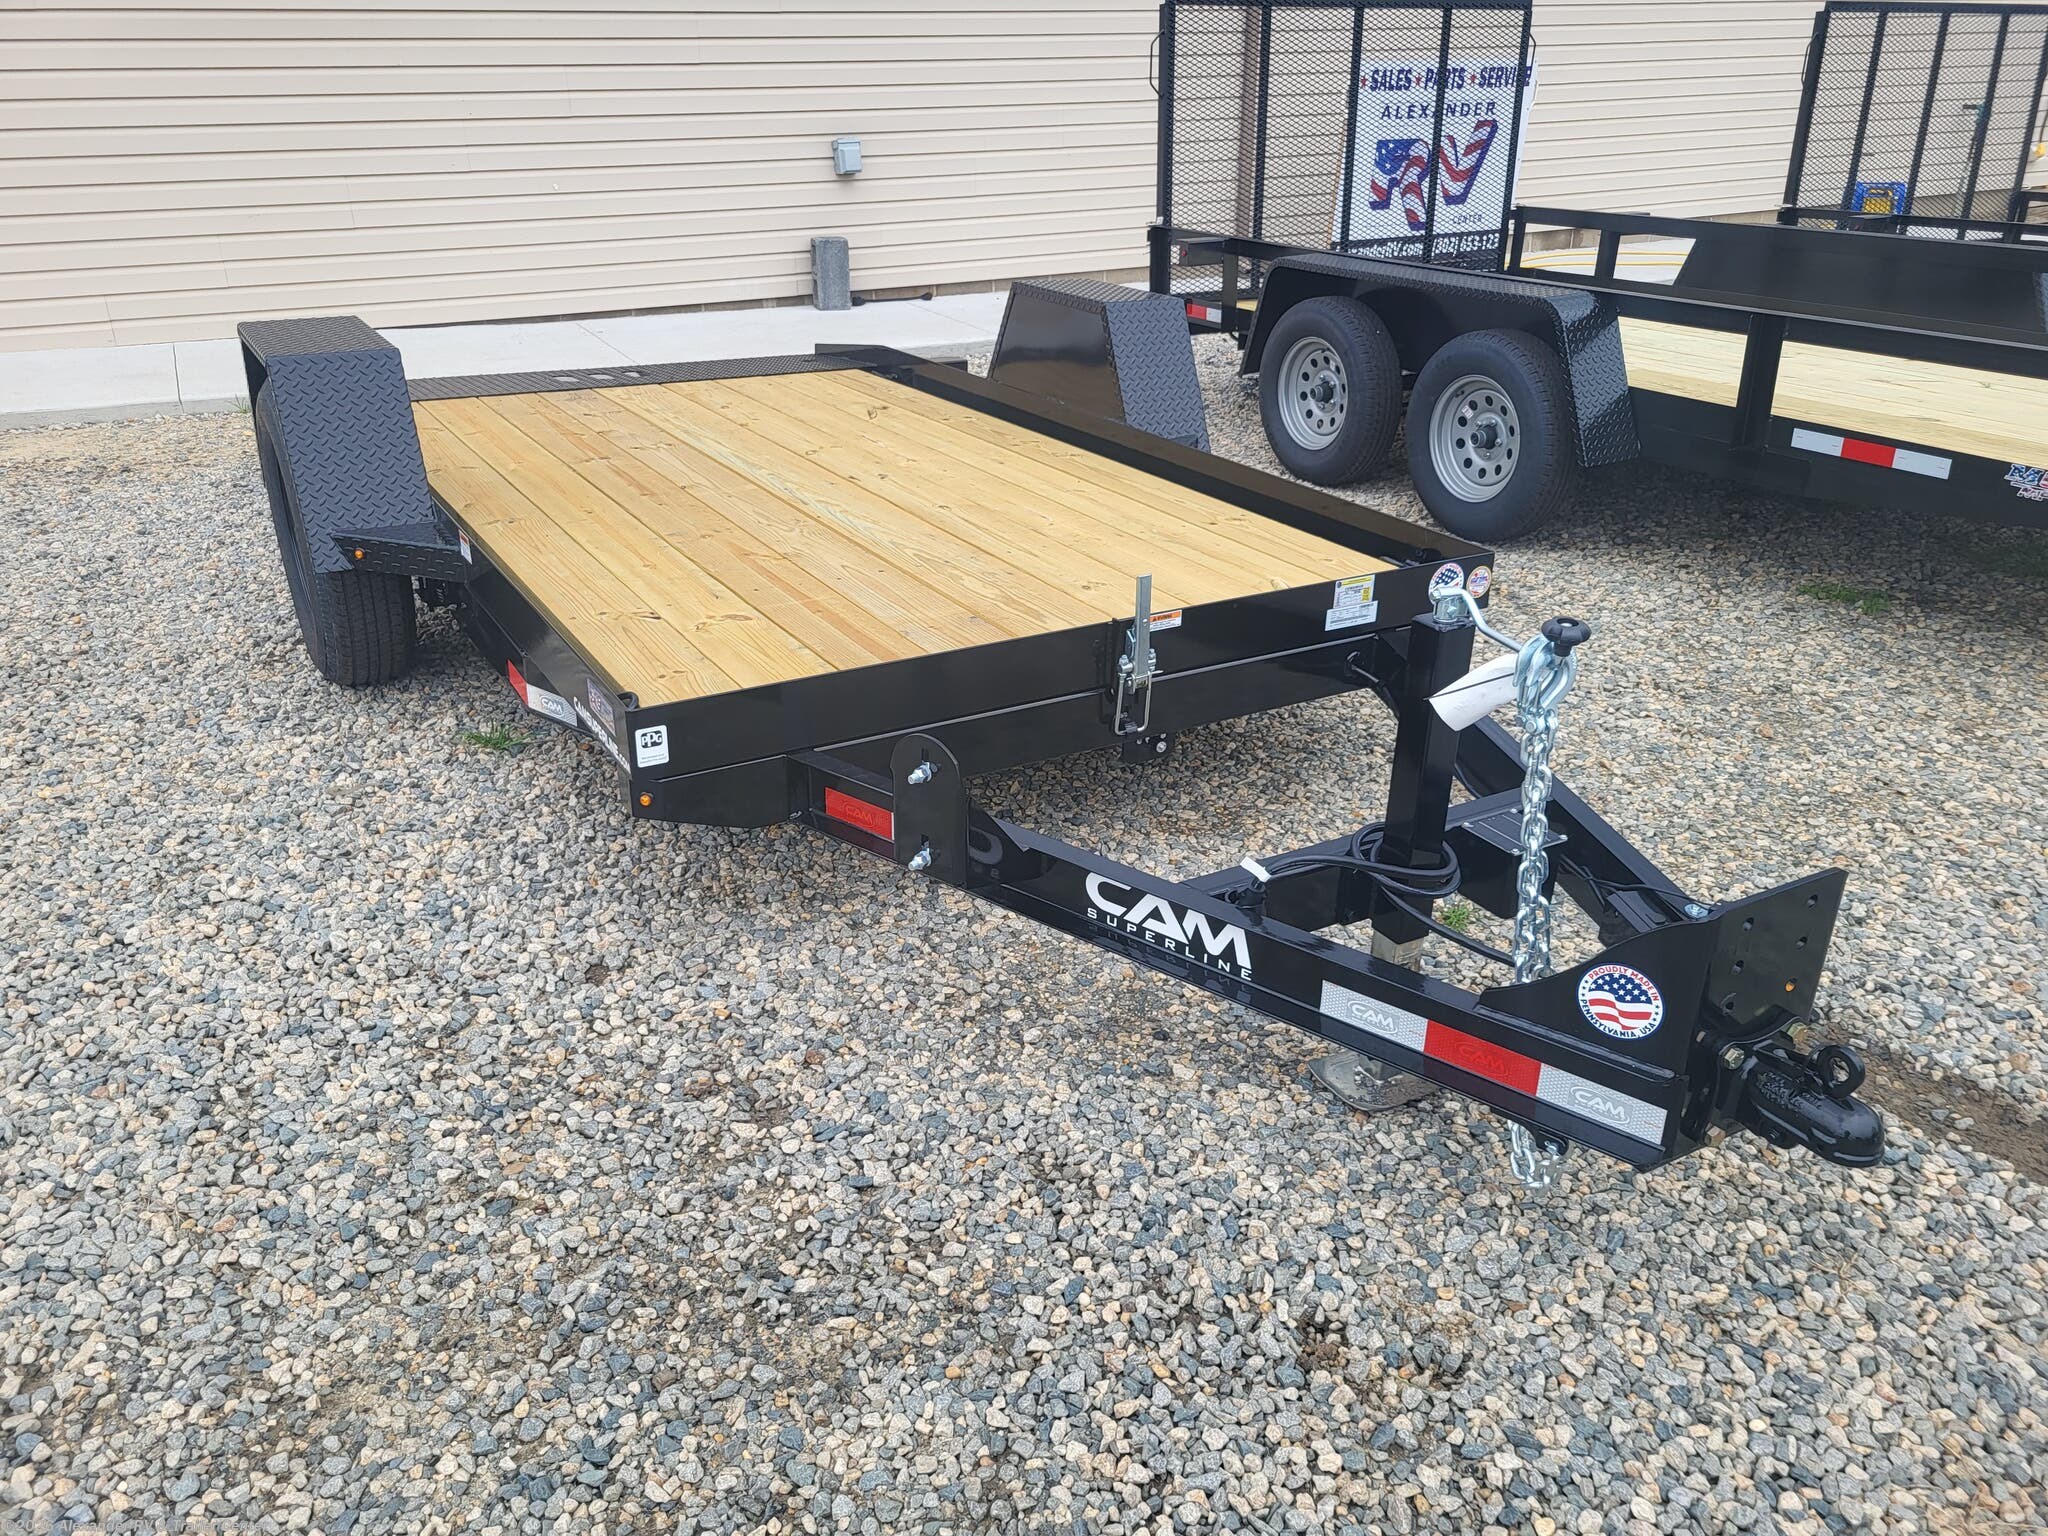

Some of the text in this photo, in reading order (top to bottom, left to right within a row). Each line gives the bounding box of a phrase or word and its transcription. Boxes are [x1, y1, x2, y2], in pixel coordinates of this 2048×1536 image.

[1370, 69, 1412, 91] SALES
[1479, 66, 1532, 88] SERVIE
[1381, 102, 1496, 120] ALEXNDER
[1460, 233, 1500, 251] 653-123
[541, 698, 563, 714] CAM
[641, 731, 662, 747] PPG
[1086, 872, 1252, 970] CAM
[1087, 907, 1252, 981] SUPERLINE
[1588, 966, 1660, 1001] PROUDLY MADE IN
[1352, 1004, 1394, 1031] CAM
[1639, 1022, 1656, 1035] USA
[1459, 1047, 1505, 1073] CAM
[1575, 1091, 1625, 1120] CAM
